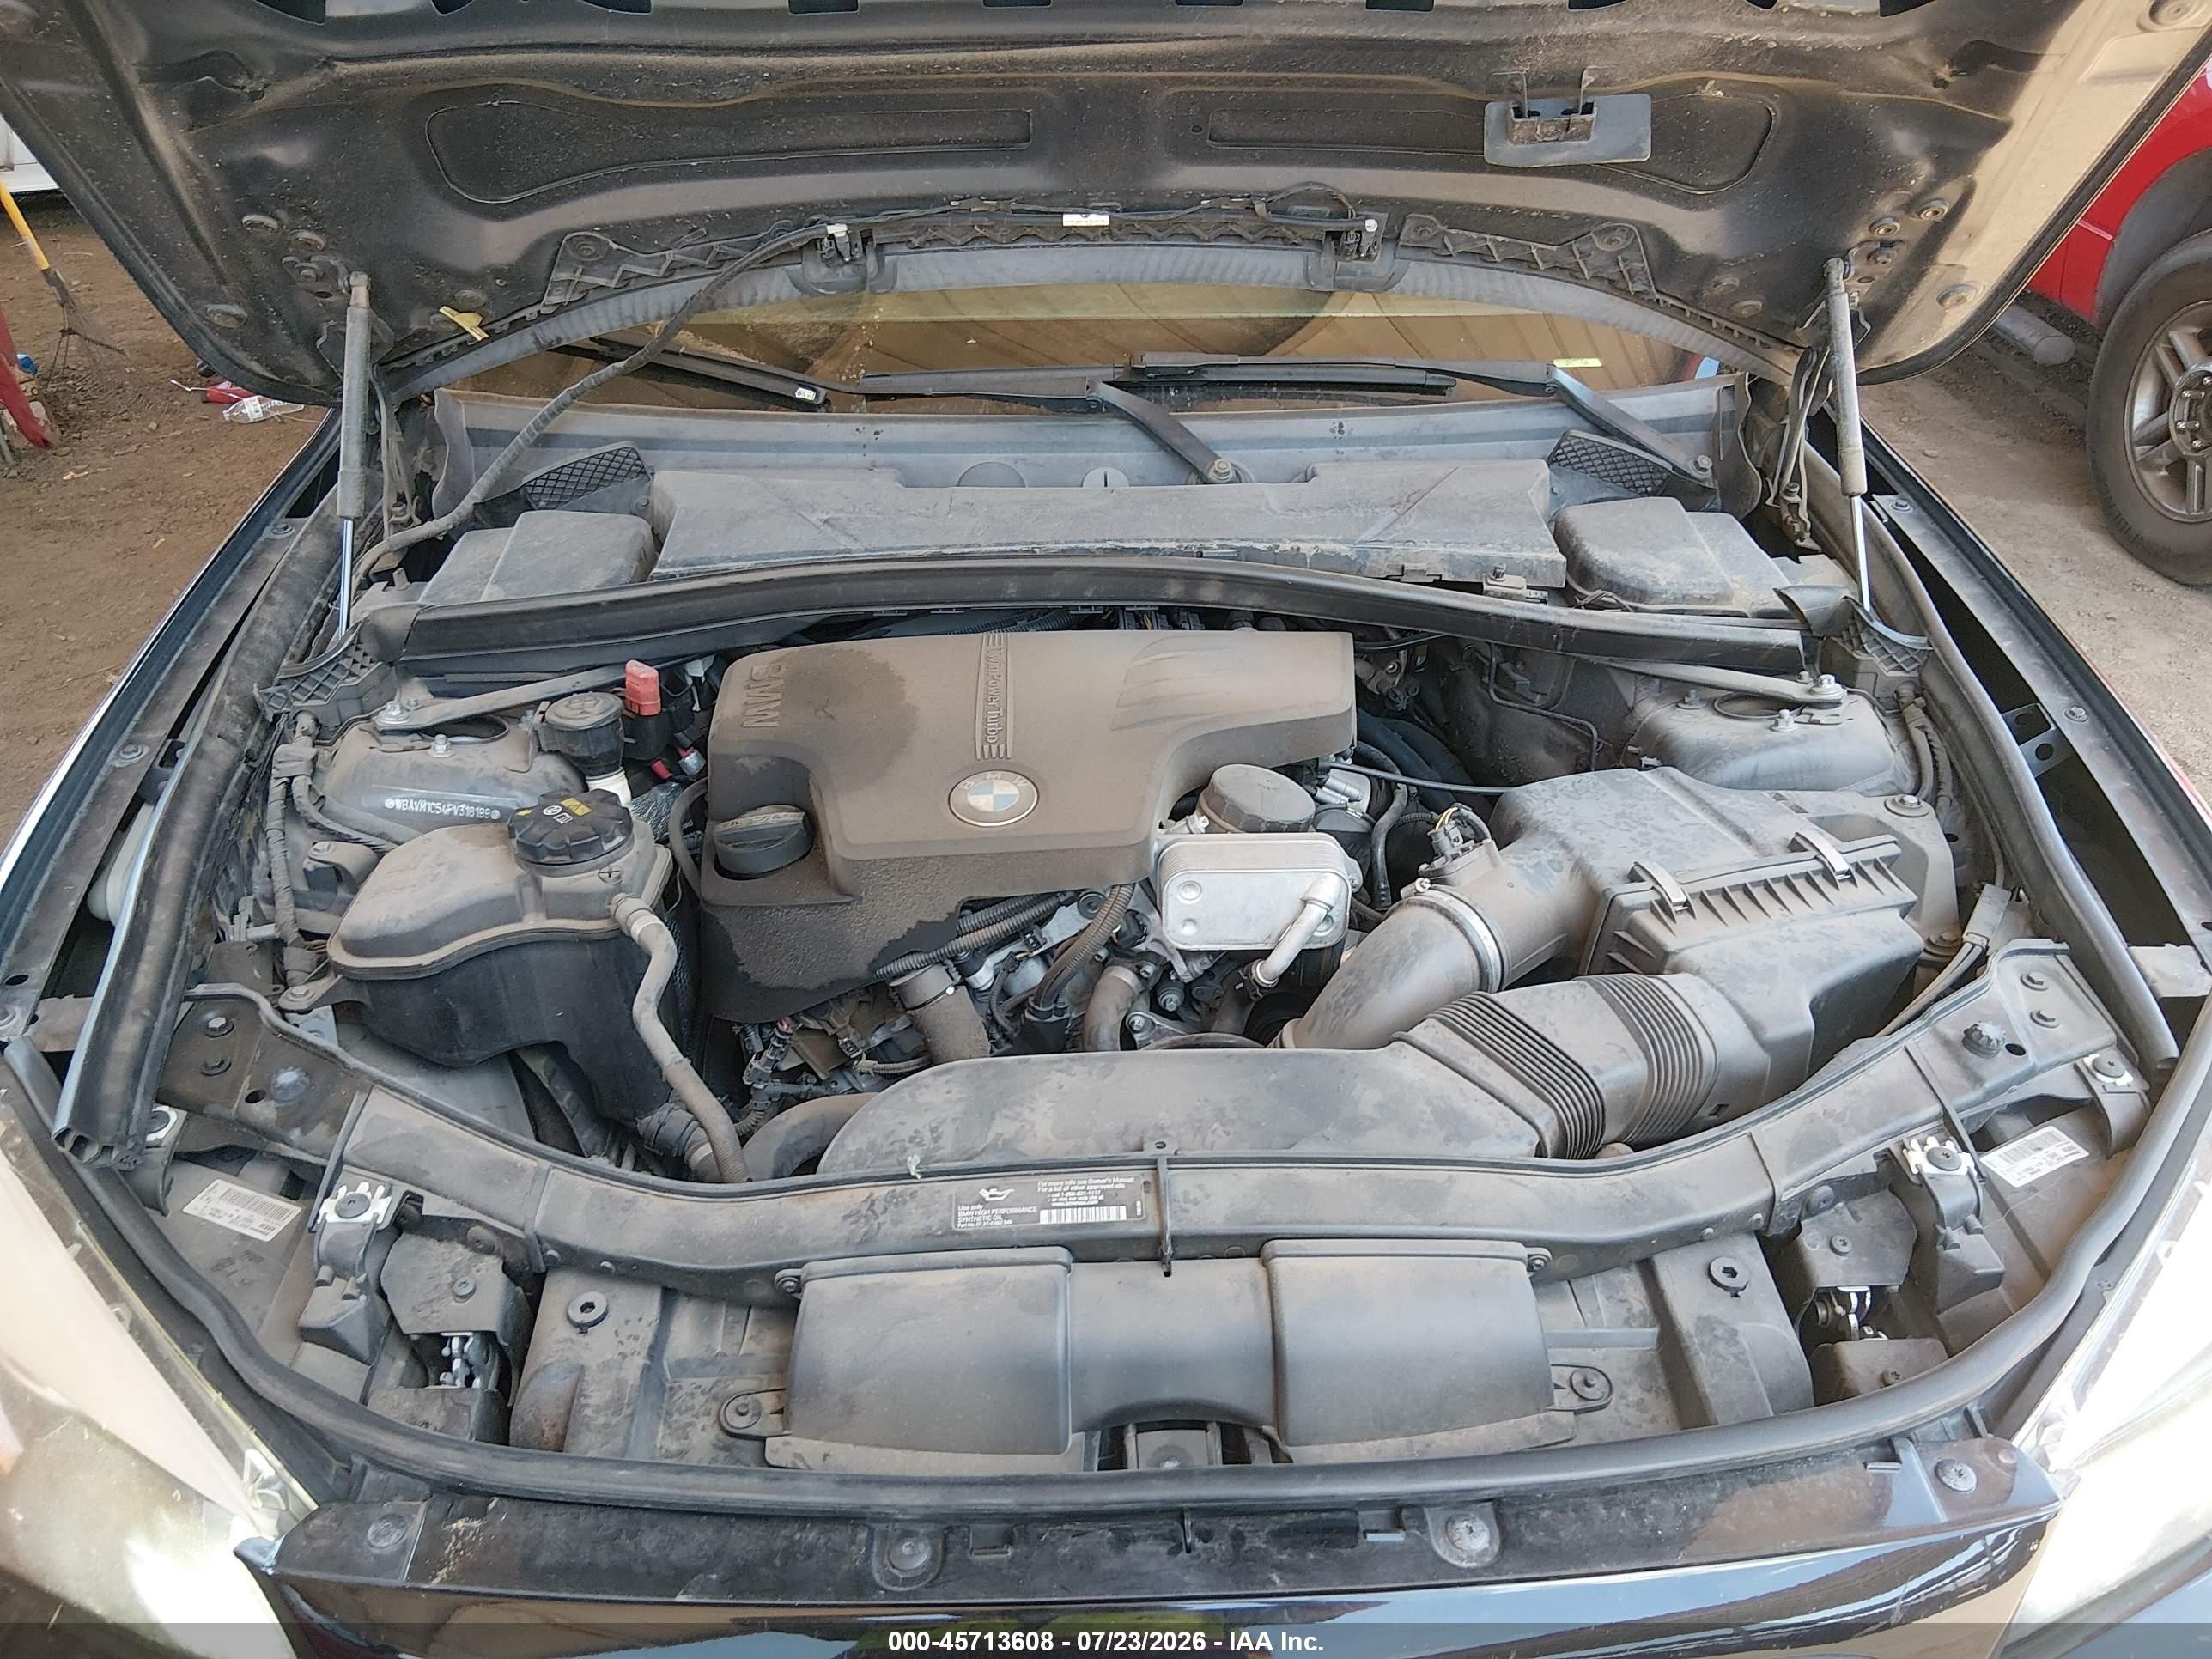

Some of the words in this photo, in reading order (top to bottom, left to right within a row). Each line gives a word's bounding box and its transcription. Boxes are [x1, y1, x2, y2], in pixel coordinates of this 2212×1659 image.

[741, 664, 787, 729] BMW
[986, 707, 1004, 744] Turbo
[959, 772, 1030, 790] BMW
[395, 798, 491, 819] WBAVM1C54FV318199
[991, 1206, 1037, 1214] PERFORMANCE
